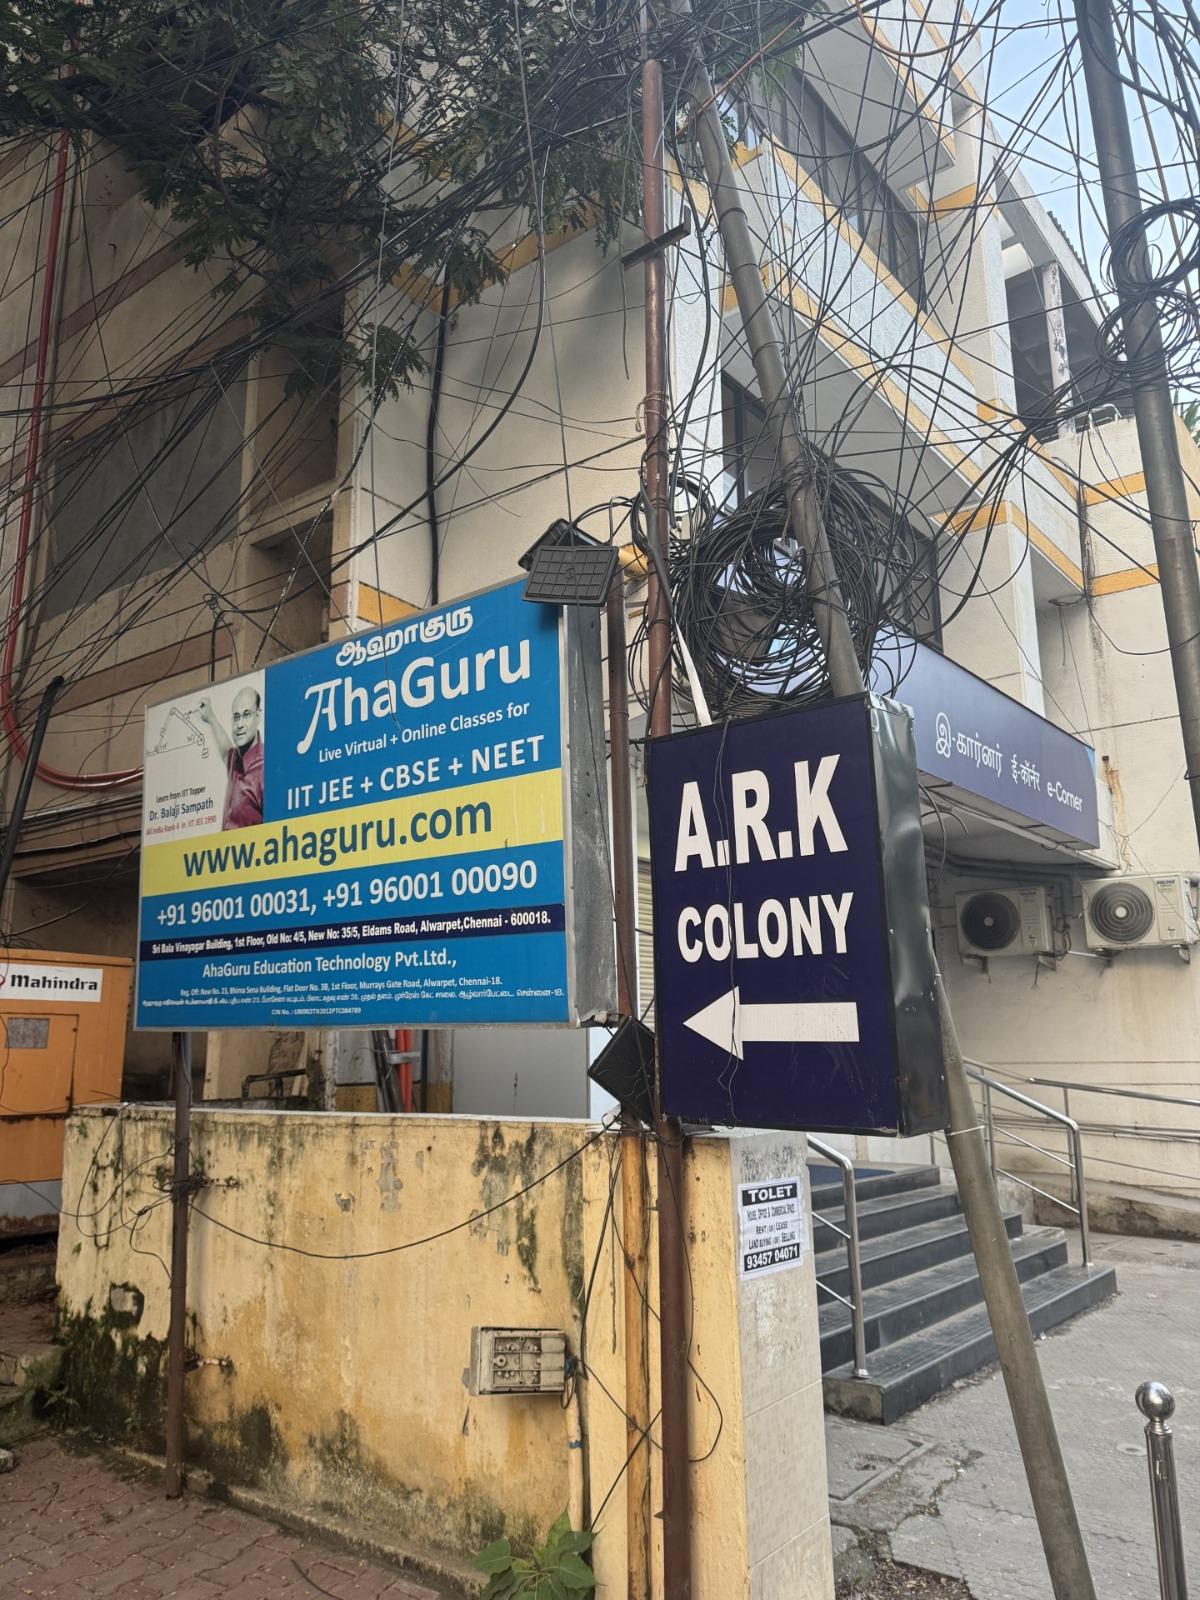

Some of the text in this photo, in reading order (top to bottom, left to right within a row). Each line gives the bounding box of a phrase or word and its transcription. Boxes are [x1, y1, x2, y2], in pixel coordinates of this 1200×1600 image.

[297, 639, 531, 755] AhaGuru
[319, 700, 530, 763] Live Virtual + Online Classes for
[288, 735, 545, 811] IIT JEE + CBSE + NEET
[149, 797, 213, 821] Dr. Balaji Sampath
[156, 786, 206, 803] Learn from IIT Topper
[1047, 781, 1083, 812] e-Corner
[674, 754, 848, 872] A.R.K
[184, 799, 491, 878] www.ahaguru.com
[157, 860, 537, 926] +91 96001 00031, +91 96001 00090
[152, 944, 161, 955] Sri
[161, 943, 174, 954] Bala
[175, 941, 205, 954] Vinayagar
[206, 938, 233, 951] Building,
[235, 936, 245, 948] 1st
[246, 935, 265, 948] Floor,
[266, 933, 278, 944] Old
[280, 932, 292, 943] No:
[308, 929, 325, 941] New
[327, 928, 339, 939] No:
[362, 923, 392, 937] Eldams
[394, 921, 419, 935] Road,
[511, 911, 551, 926] 600018.
[677, 892, 854, 963] COLONY
[203, 948, 457, 978] AhaGuru Education Technology Pvt.Ltd.,
[10, 974, 98, 991] Mahindra
[260, 985, 282, 994] Building,
[283, 984, 294, 992] Flat
[295, 984, 309, 992] Door
[309, 983, 319, 991] No.
[331, 982, 341, 990] 1st
[341, 981, 358, 991] Floor,
[359, 981, 385, 990] Murrays
[386, 980, 401, 988] Gate
[403, 979, 422, 988] Road,
[423, 978, 457, 988] Alwarpet,
[459, 976, 502, 986] Chennai-18.
[748, 1186, 793, 1203] TOLET
[748, 1239, 758, 1250] LAND
[781, 1231, 795, 1243] SELLING
[756, 1225, 766, 1235] RENT
[775, 1220, 788, 1230] LEASE
[747, 1245, 798, 1269] 93457 04071
